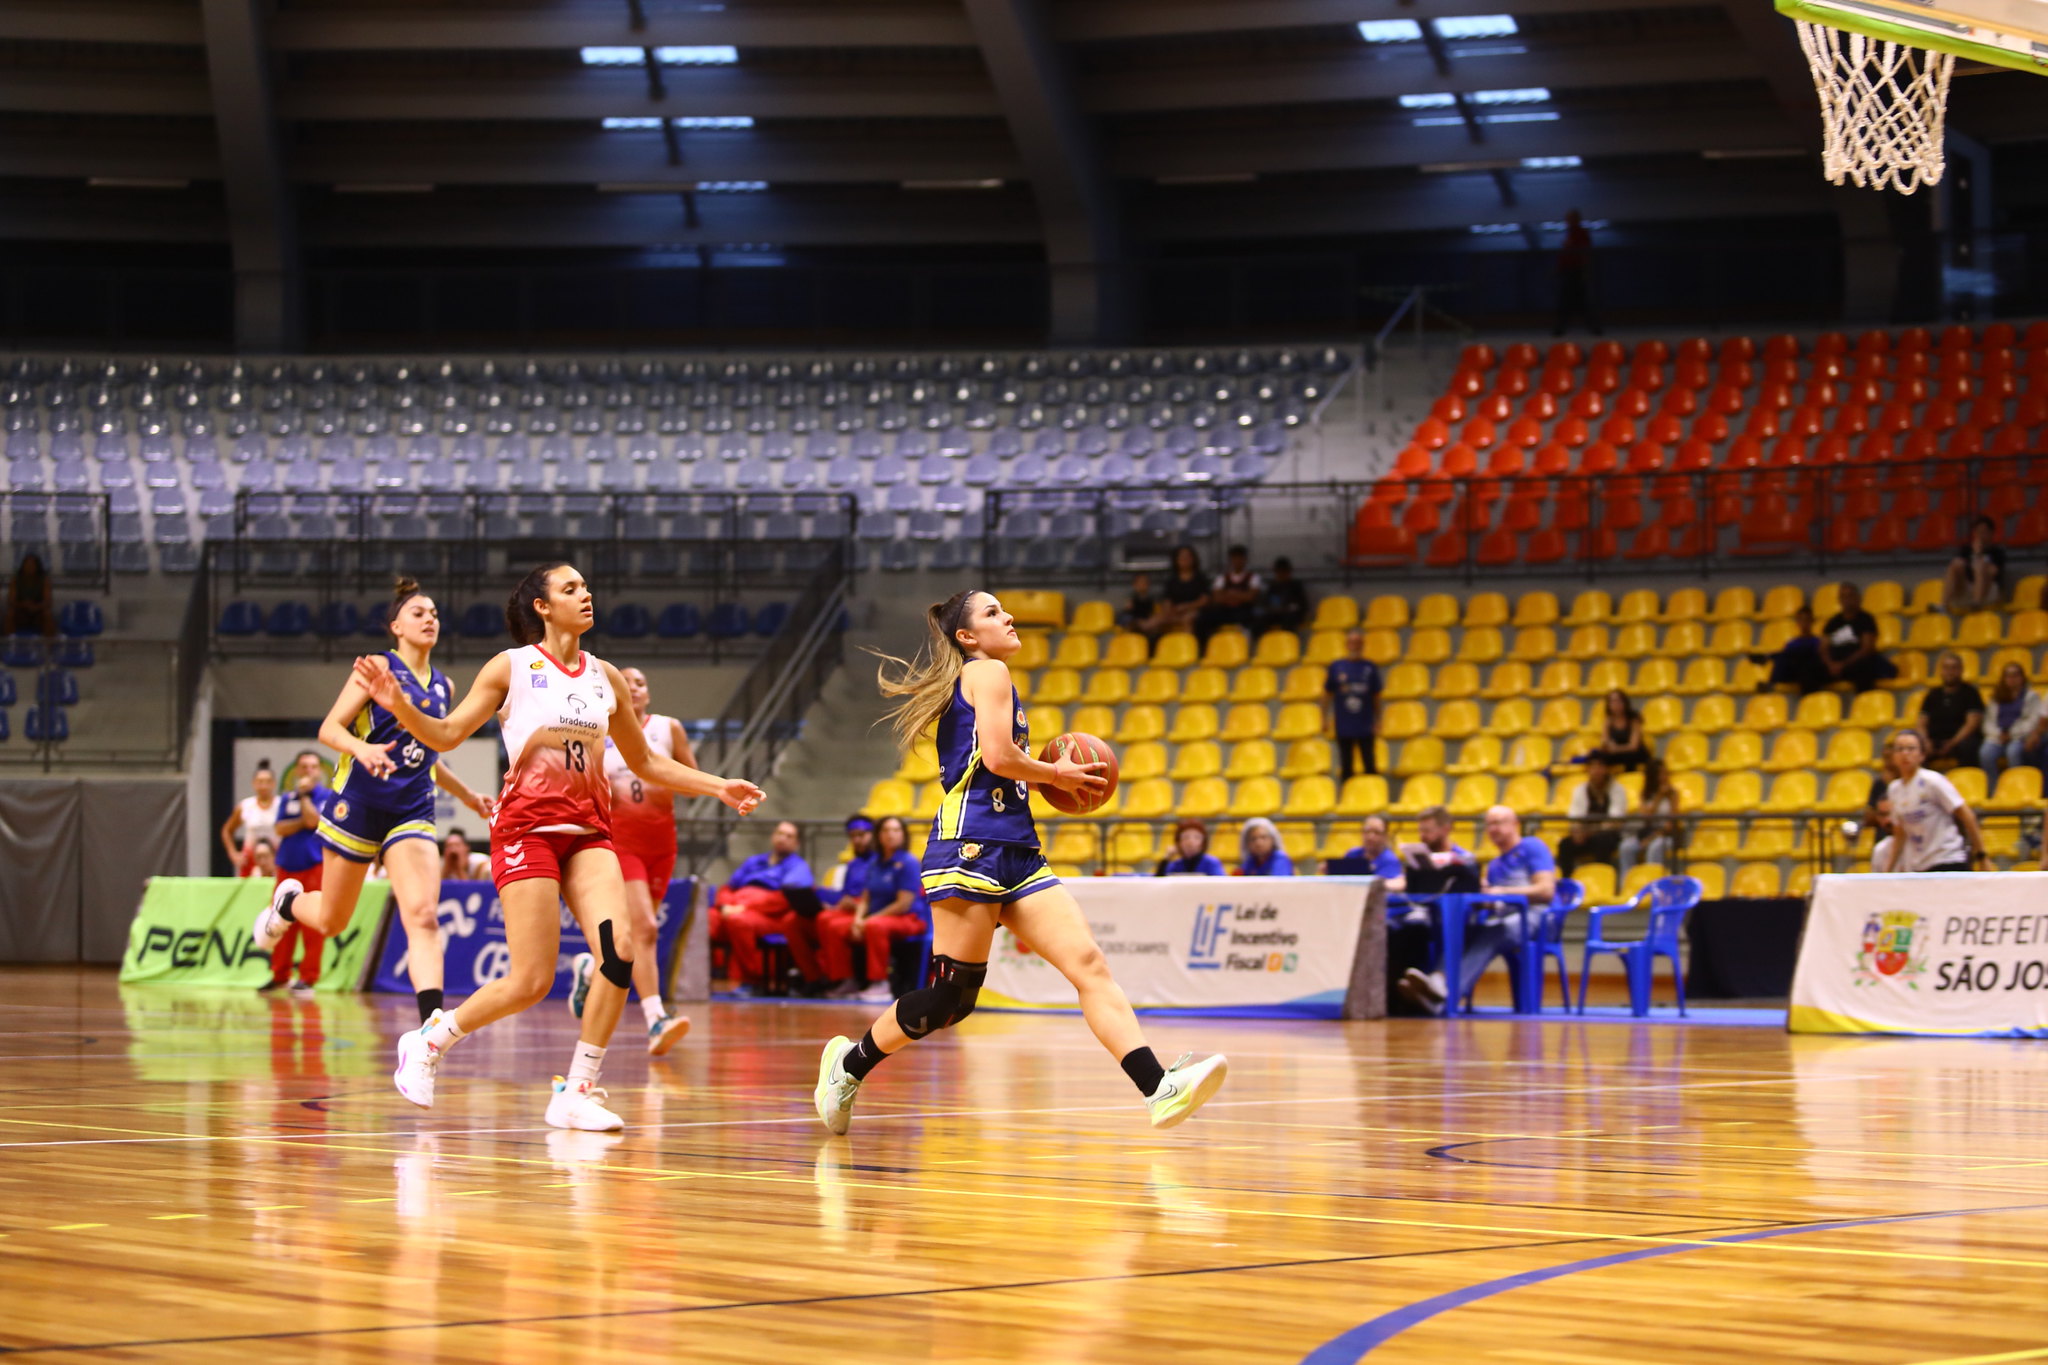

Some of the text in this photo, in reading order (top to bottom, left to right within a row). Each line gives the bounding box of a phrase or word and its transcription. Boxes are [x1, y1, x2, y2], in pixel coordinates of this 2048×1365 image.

[559, 715, 598, 730] bradesco
[562, 739, 586, 773] 13
[631, 780, 644, 804] 8
[1235, 902, 1278, 920] Lei de
[1230, 927, 1299, 946] Incentivo
[137, 926, 360, 969] PENAY
[1225, 953, 1267, 971] Fiscal
[1934, 954, 2048, 991] SÃO JO
